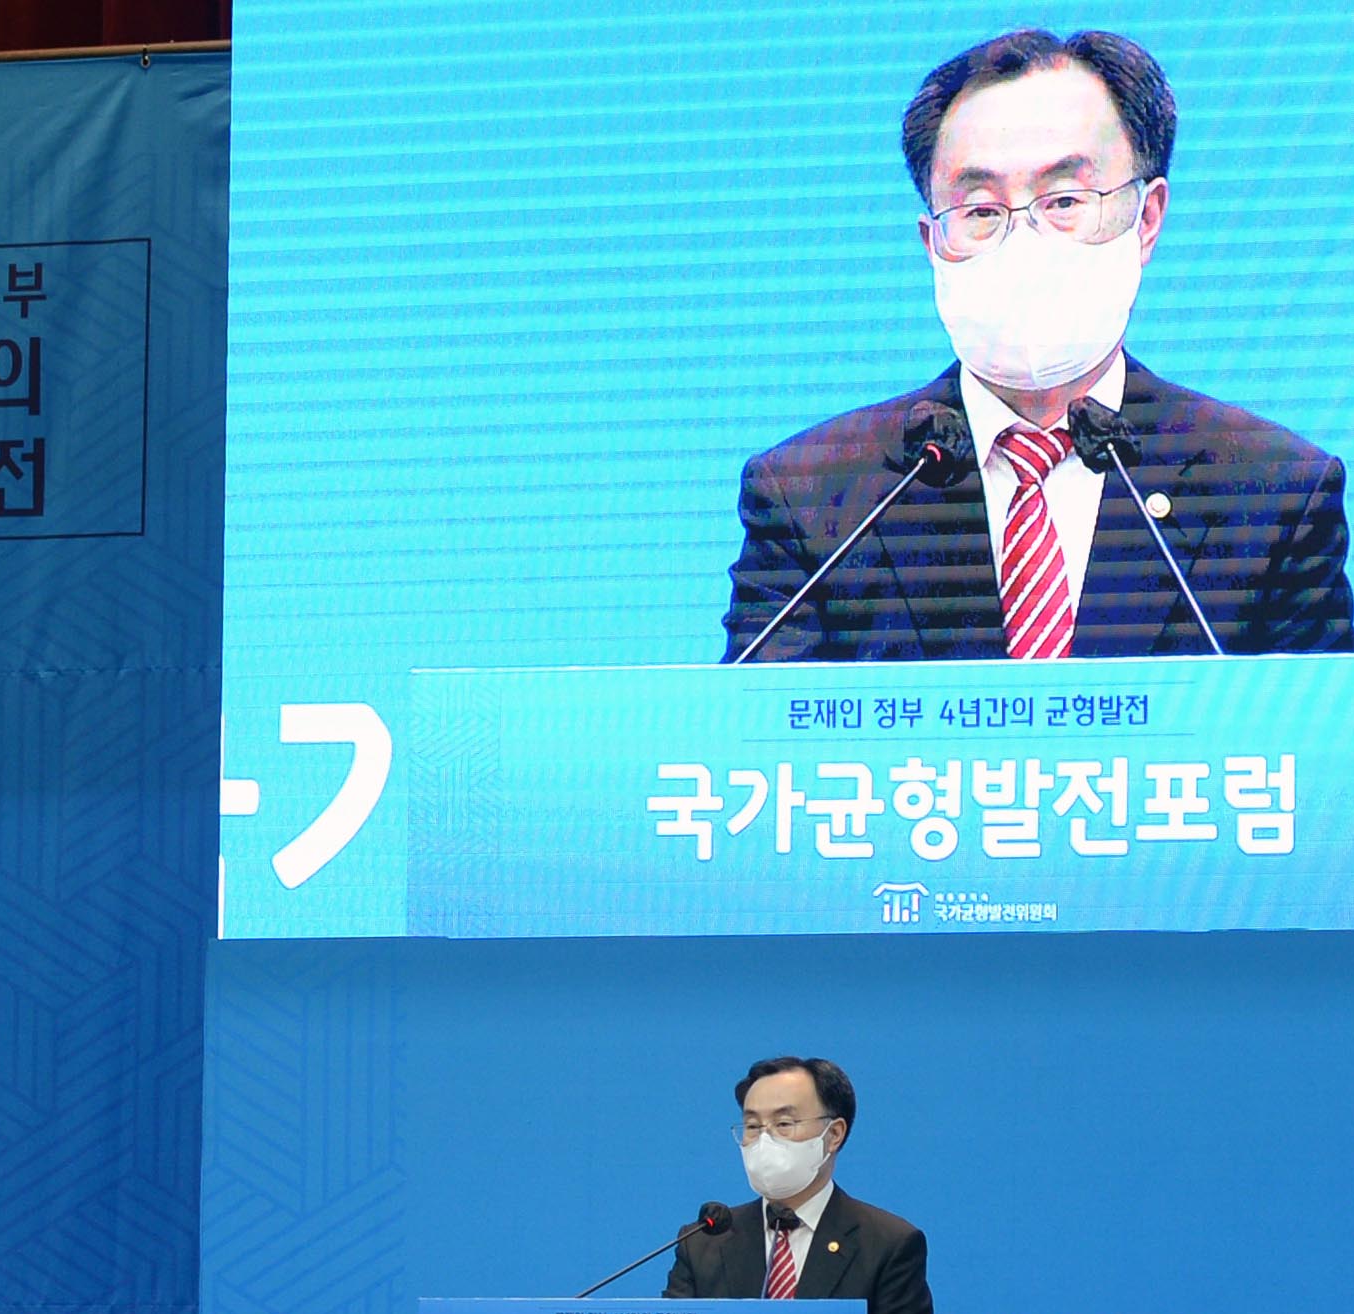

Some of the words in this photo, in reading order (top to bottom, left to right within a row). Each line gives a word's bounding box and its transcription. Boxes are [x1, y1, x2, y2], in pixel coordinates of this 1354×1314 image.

[787, 697, 862, 729] 문재인
[873, 697, 924, 729] 정부
[939, 696, 1034, 728] 4년간의
[1045, 694, 1149, 727] 균형발전
[645, 754, 1297, 862] 국가균형발전포럼
